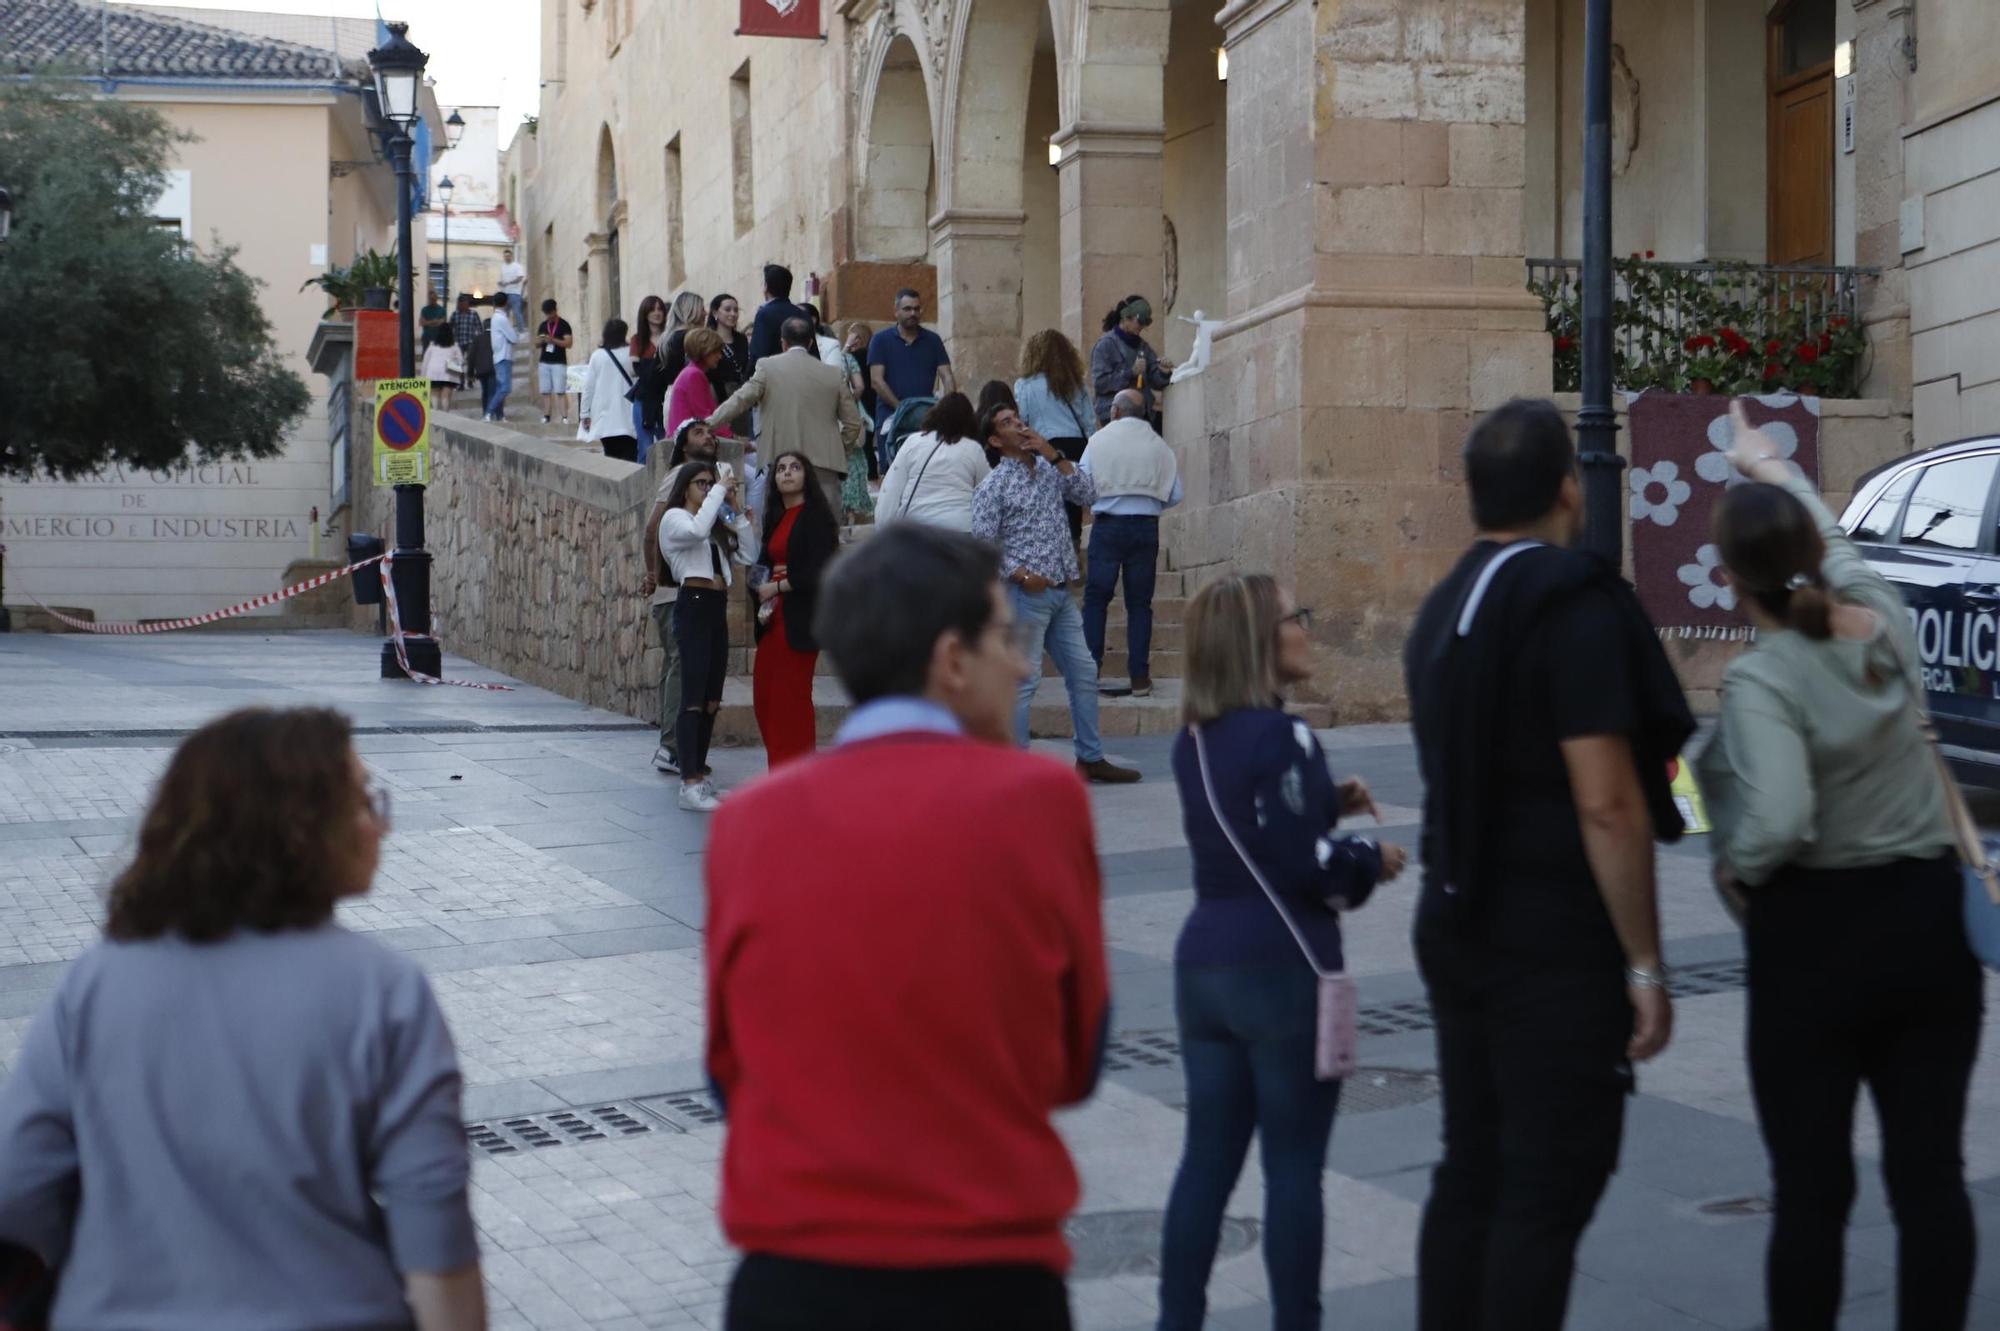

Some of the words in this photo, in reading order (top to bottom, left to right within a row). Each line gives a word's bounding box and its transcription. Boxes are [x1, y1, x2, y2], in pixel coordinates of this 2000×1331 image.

[121, 493, 147, 509] DE
[0, 517, 115, 537] MERCIO
[152, 518, 298, 538] INDUSTRIA
[1920, 667, 1956, 693] RCA
